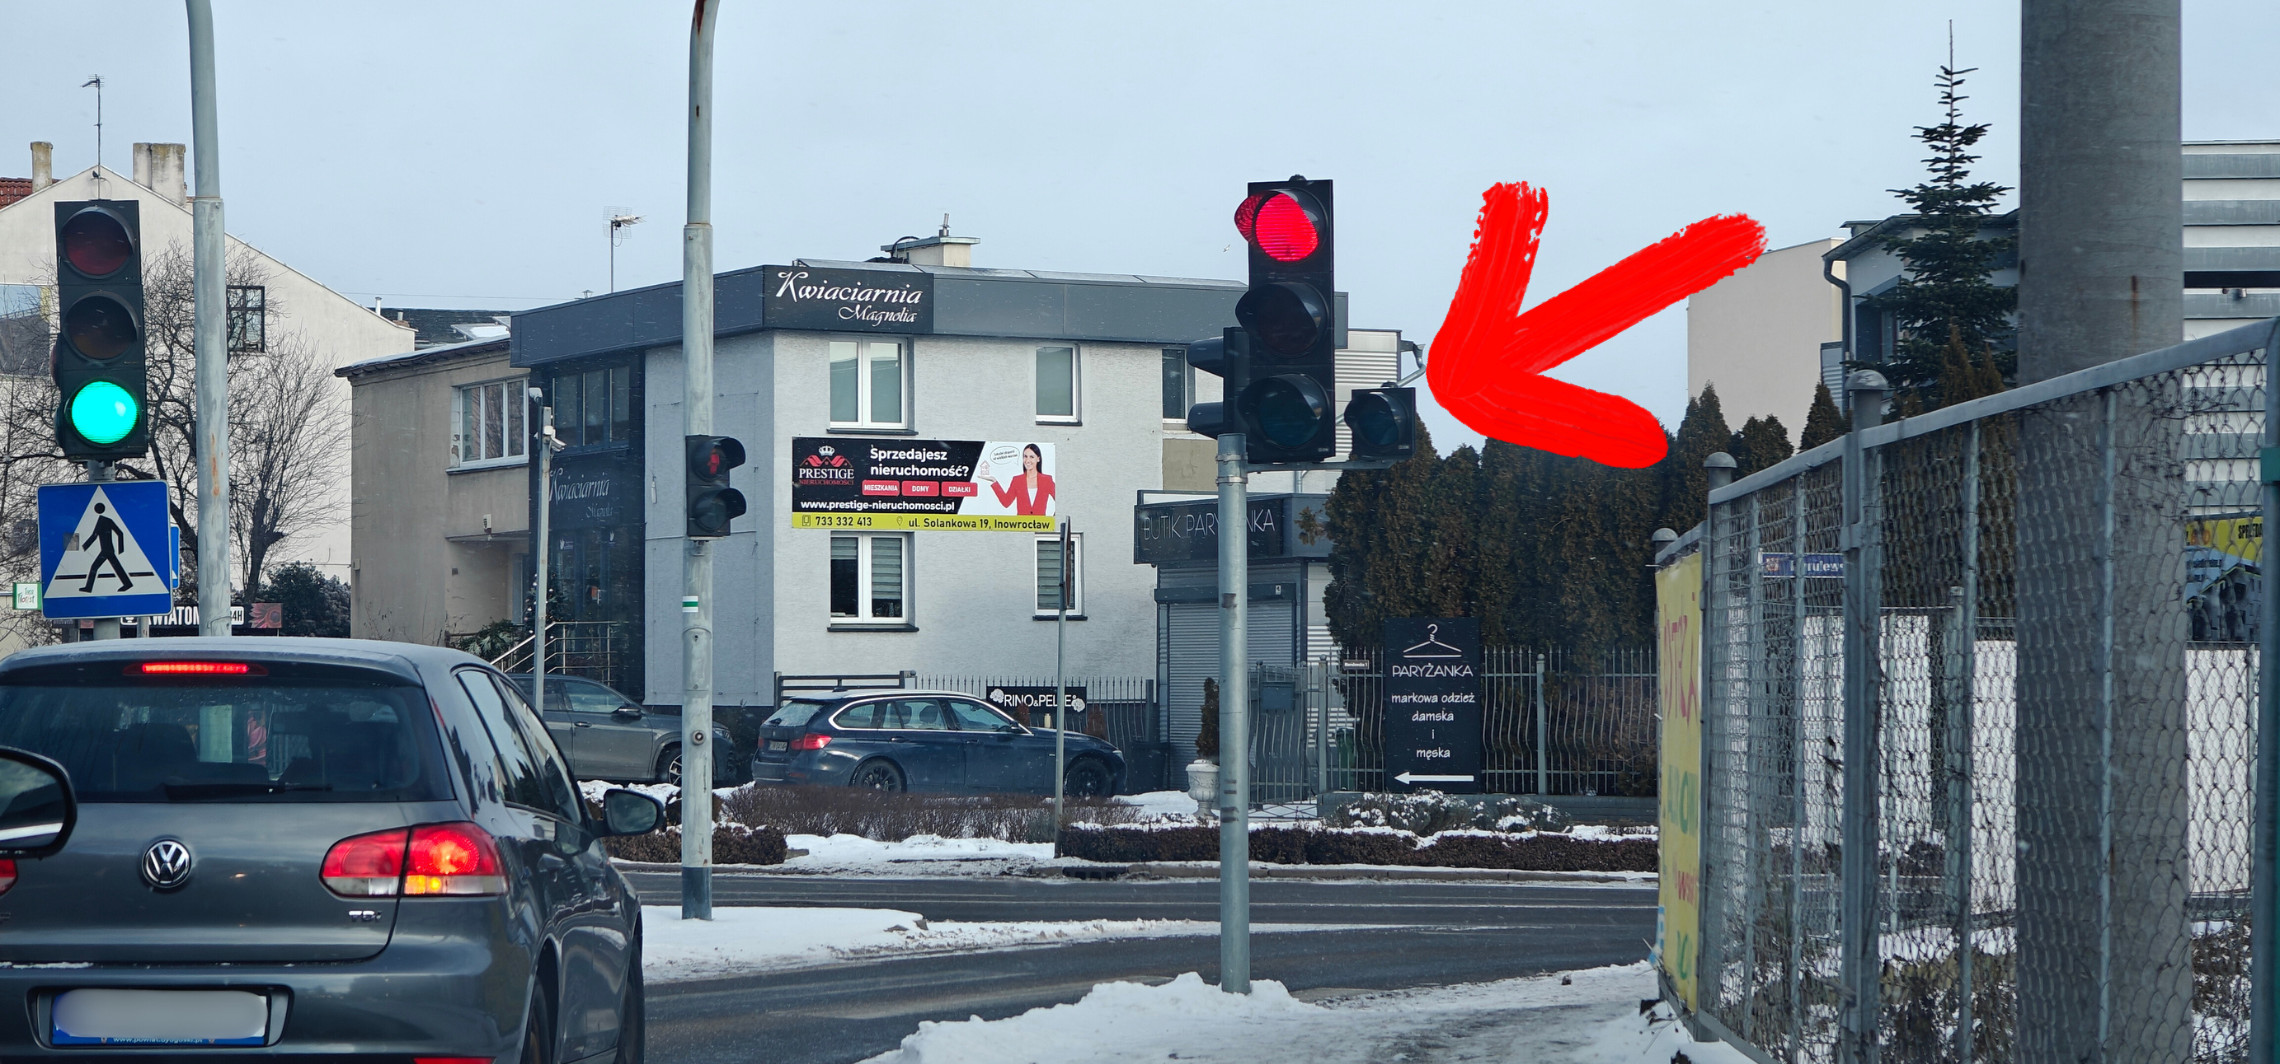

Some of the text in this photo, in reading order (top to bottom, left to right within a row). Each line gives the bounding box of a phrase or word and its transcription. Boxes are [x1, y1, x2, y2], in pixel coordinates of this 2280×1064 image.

[776, 271, 923, 304] Kwiaciarnia
[838, 304, 917, 327] Magnolia
[870, 448, 947, 462] Sprzedajesz
[799, 468, 854, 479] PRESTIGE
[871, 464, 969, 477] nieruchomość?
[864, 484, 898, 492] MIESZKANIA
[801, 500, 955, 512] www.prestige-nieruchomosci.pl
[816, 516, 872, 526] 733 332 413
[909, 518, 1050, 529] ul. Solankowa 19, Inowrocław
[1144, 509, 1275, 541] BUTIK PARNKA
[1392, 663, 1473, 678] PARYŻANKA
[1004, 694, 1071, 707] RINO&PELE
[1391, 692, 1475, 703] markowa odzież
[1412, 710, 1454, 721] damska
[1431, 729, 1435, 740] i
[1416, 747, 1451, 760] męska
